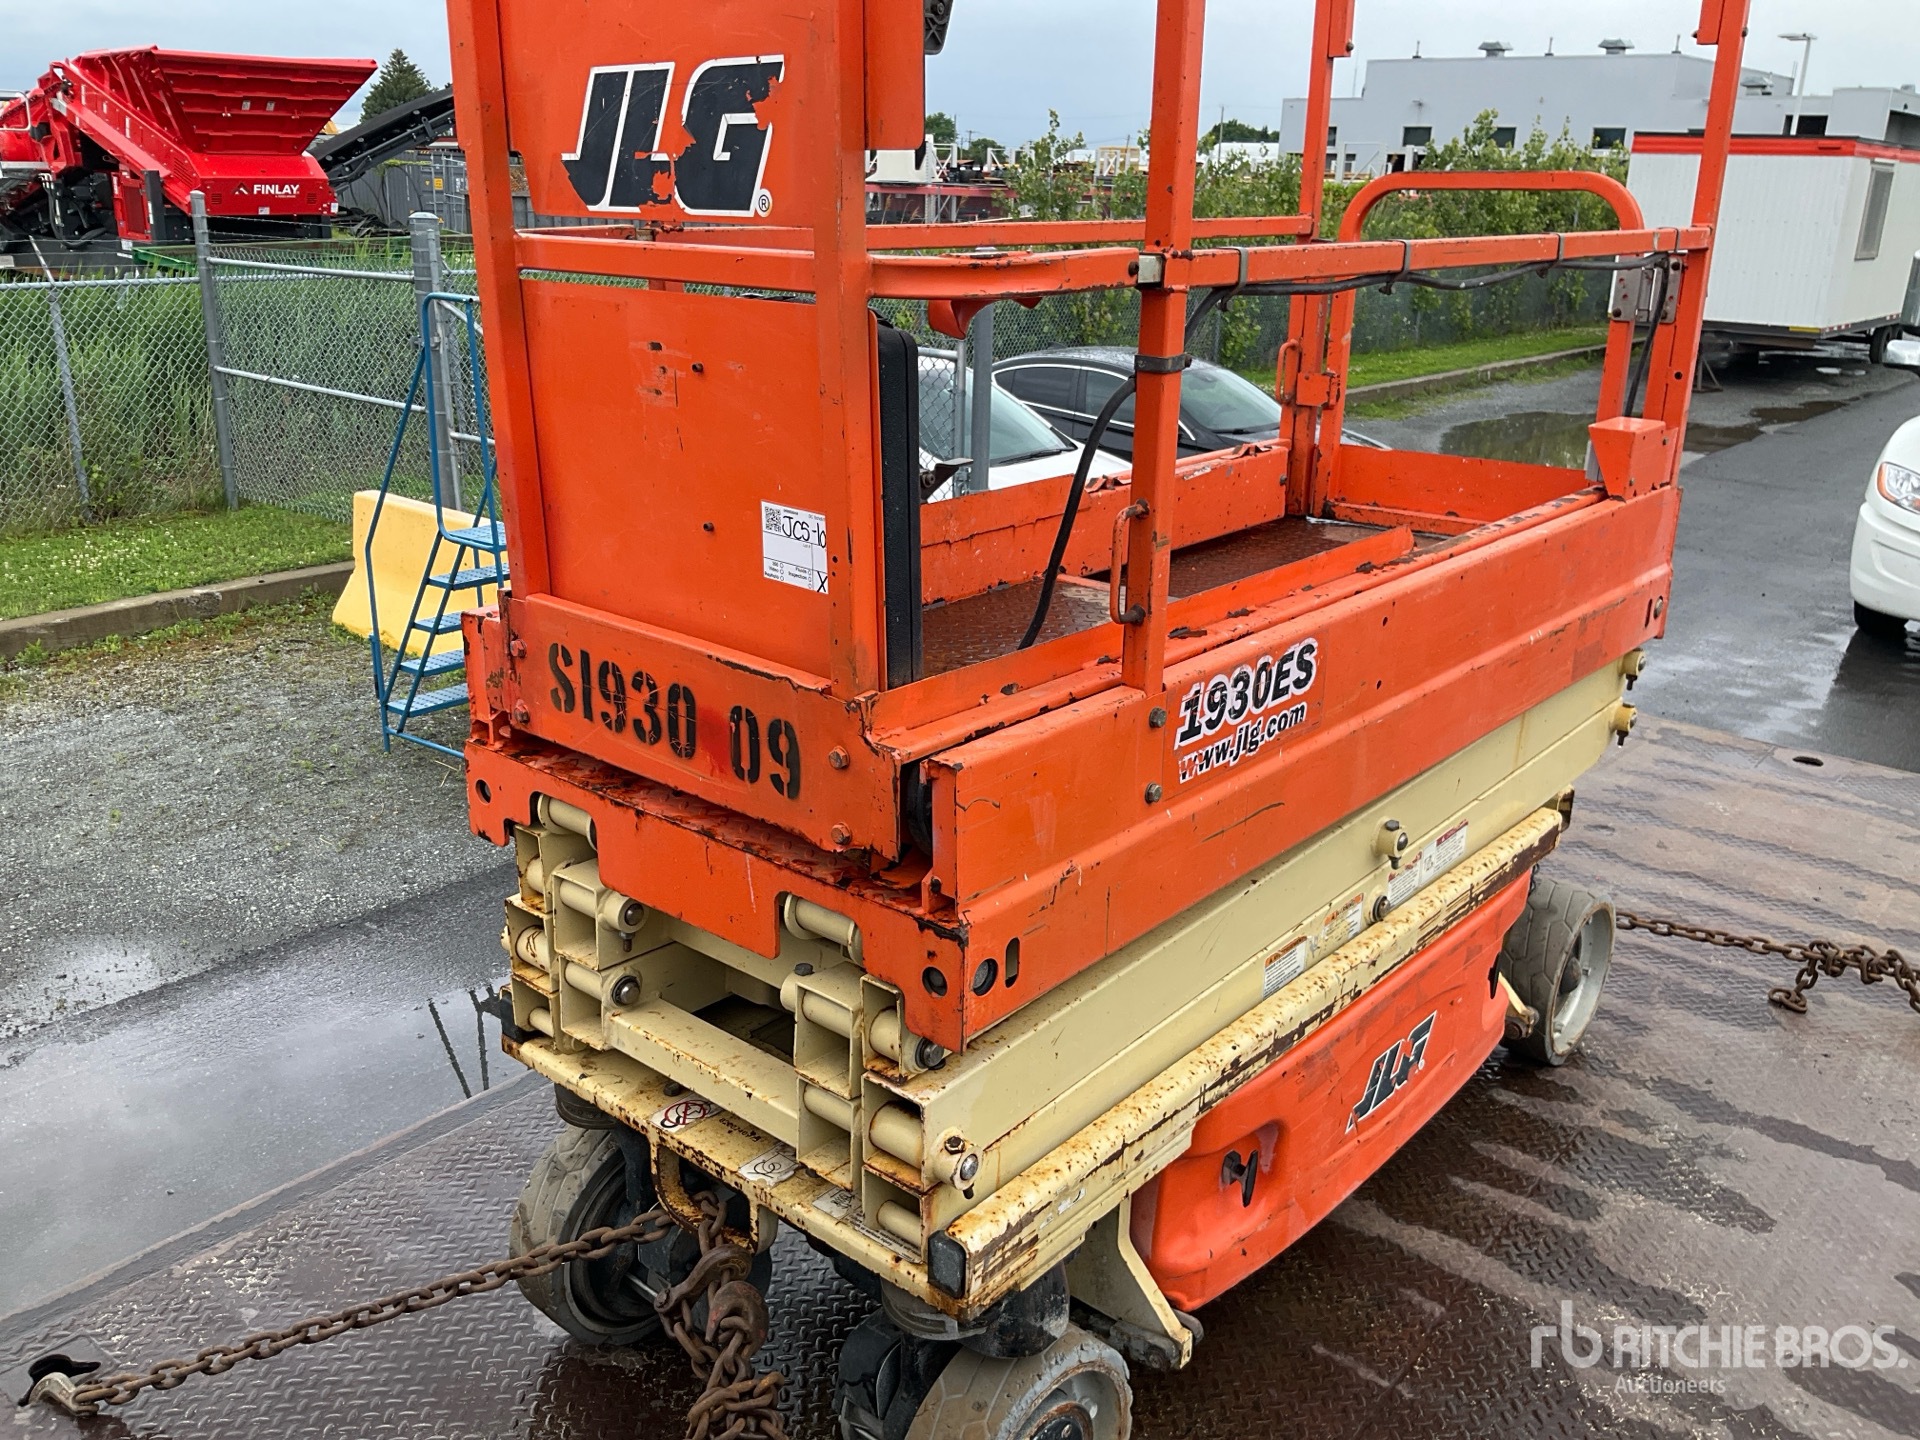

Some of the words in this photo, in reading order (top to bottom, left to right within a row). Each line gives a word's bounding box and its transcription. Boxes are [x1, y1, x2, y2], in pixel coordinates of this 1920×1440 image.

[561, 54, 785, 217] JLG
[253, 184, 300, 195] FINLAY
[1176, 638, 1318, 748] 1930ES
[730, 705, 800, 800] 09
[1179, 702, 1307, 784] www.jlg.com
